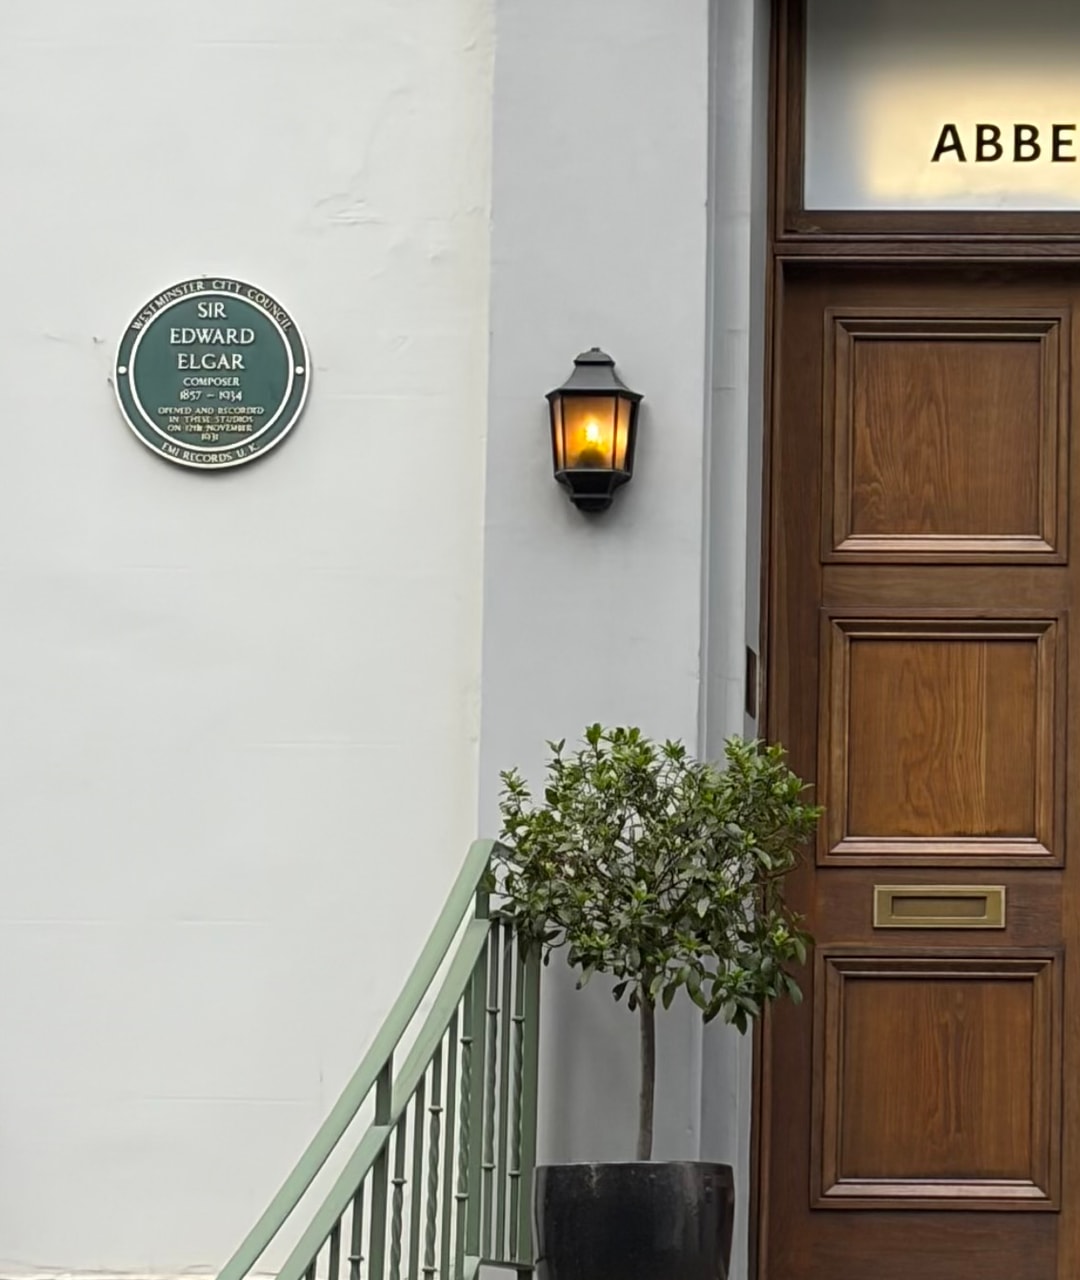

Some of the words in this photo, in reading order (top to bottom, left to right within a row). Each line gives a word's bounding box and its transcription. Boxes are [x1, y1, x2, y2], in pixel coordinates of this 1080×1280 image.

[131, 280, 205, 331] WESTMINSTER
[212, 280, 241, 293] CITY
[247, 288, 292, 332] COUNCIL
[197, 302, 227, 318] SIR
[170, 328, 255, 344] EDWARD
[177, 353, 245, 370] ELGAR
[183, 376, 240, 387] COMPOSER
[179, 389, 202, 401] 1857
[218, 390, 242, 402] 1934
[161, 442, 181, 456] EMI
[183, 451, 233, 463] RECORDS
